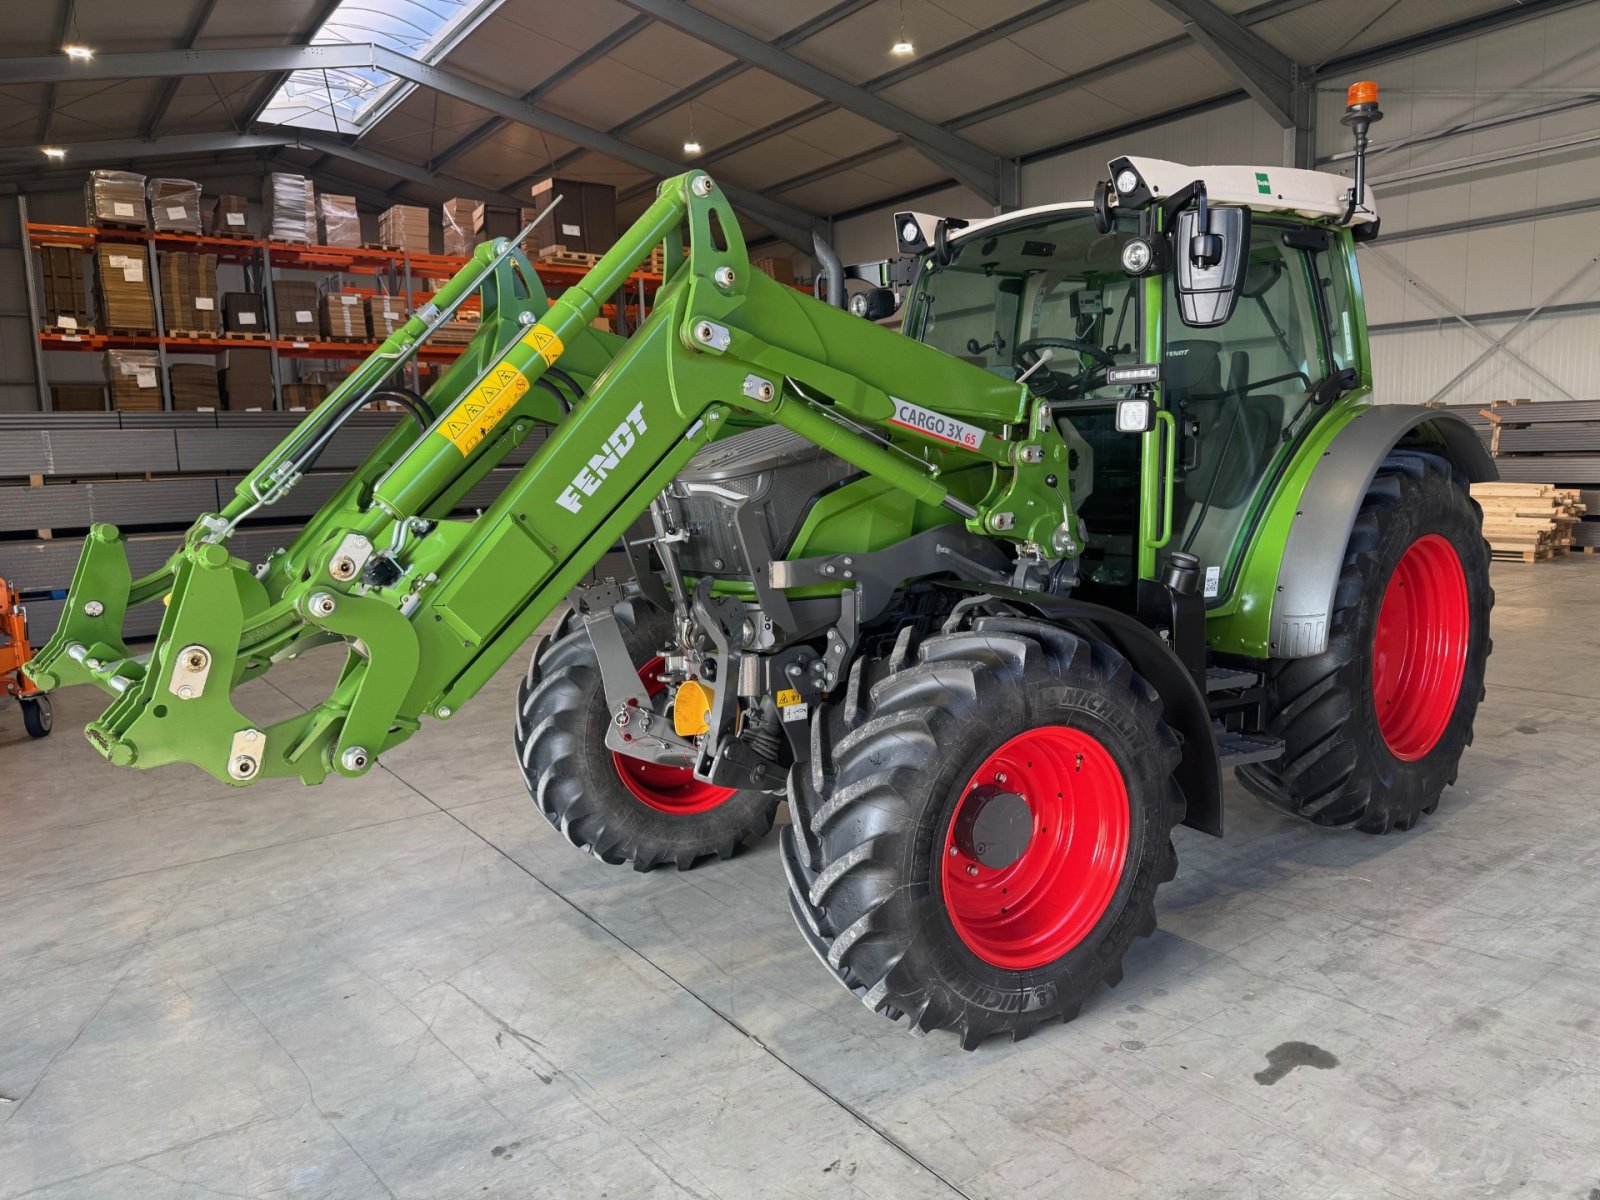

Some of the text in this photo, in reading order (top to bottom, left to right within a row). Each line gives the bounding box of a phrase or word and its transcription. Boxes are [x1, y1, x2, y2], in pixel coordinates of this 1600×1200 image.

[555, 401, 648, 515] FENDT
[900, 406, 976, 446] CARGO 3X 65
[1062, 688, 1143, 752] MICHELIN
